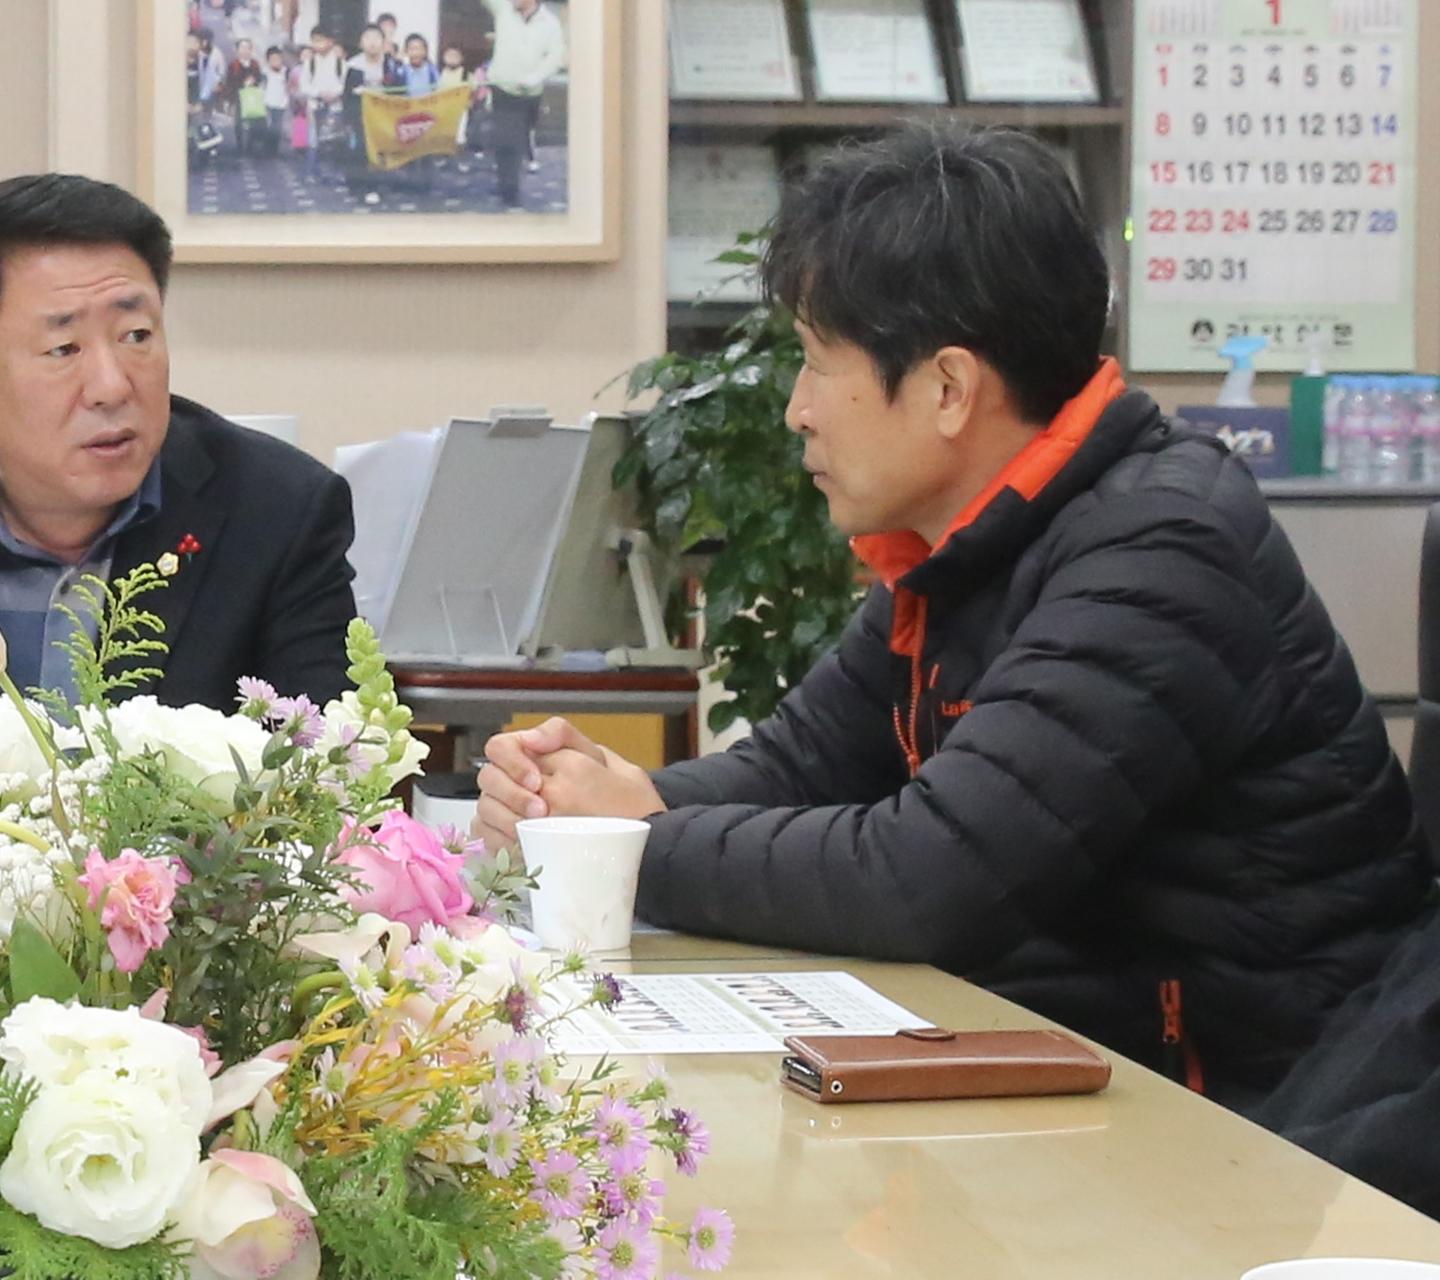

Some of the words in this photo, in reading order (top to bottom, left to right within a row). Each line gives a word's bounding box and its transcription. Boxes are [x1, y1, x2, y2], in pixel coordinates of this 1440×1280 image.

[1159, 65, 1168, 87] 1
[1193, 65, 1208, 87] 2
[1230, 65, 1245, 87] 3
[1267, 65, 1281, 87] 4
[1304, 65, 1319, 87] 5
[1340, 65, 1355, 87] 6
[1378, 65, 1391, 87] 7
[1154, 113, 1170, 136] 8
[1192, 113, 1207, 136] 9
[1224, 113, 1251, 136] 10
[1262, 113, 1286, 136] 11
[1299, 113, 1326, 136] 12
[1336, 113, 1362, 136] 13
[1372, 113, 1398, 136] 14
[1149, 161, 1176, 184] 15
[1187, 161, 1214, 184] 16
[1224, 161, 1250, 184] 17
[1261, 161, 1288, 184] 18
[1298, 161, 1325, 184] 19
[1332, 161, 1361, 184] 20
[1368, 161, 1395, 184] 21
[1148, 210, 1177, 233] 22
[1184, 210, 1213, 233] 23
[1222, 210, 1250, 233] 24
[1258, 210, 1287, 233] 25
[1295, 210, 1323, 233] 26
[1332, 210, 1360, 233] 27
[1367, 210, 1398, 233] 28
[1147, 258, 1177, 281] 29
[1183, 258, 1213, 281] 30
[1220, 258, 1248, 281] 31
